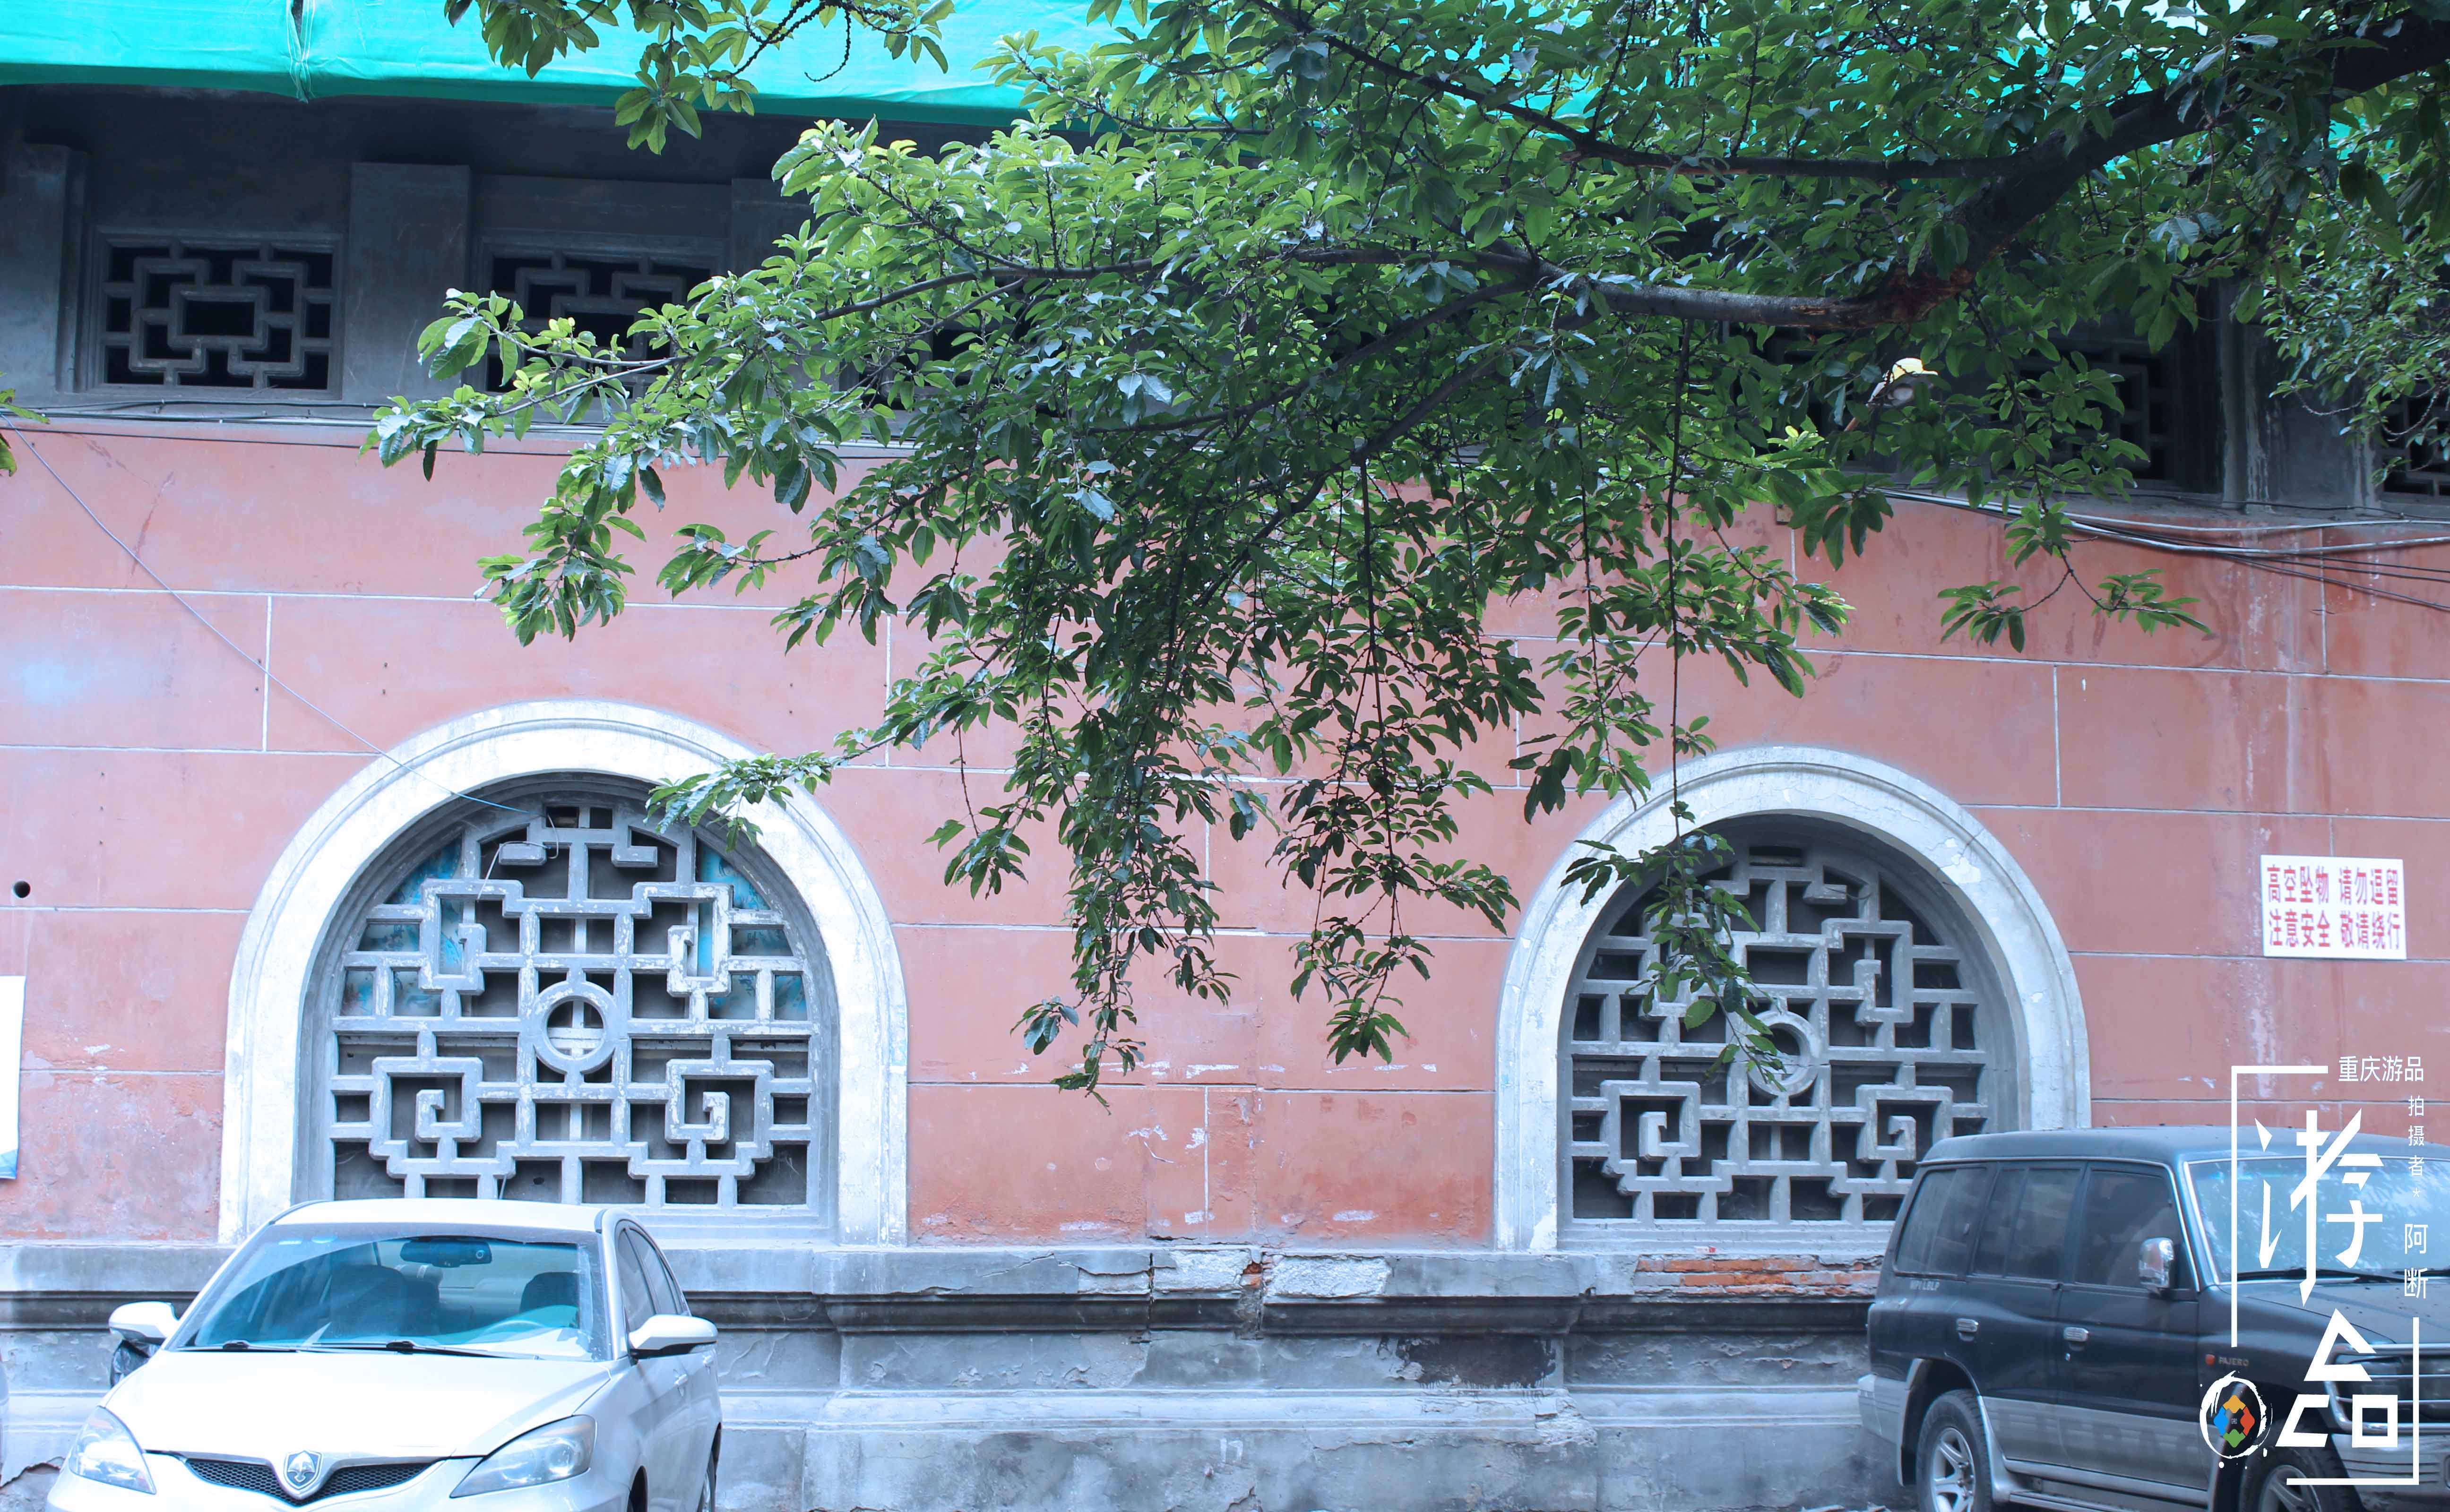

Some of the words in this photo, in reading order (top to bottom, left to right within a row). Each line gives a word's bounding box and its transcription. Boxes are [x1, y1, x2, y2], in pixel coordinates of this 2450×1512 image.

[2267, 864, 2329, 904] 高空坠物
[2338, 866, 2398, 906] 请勿逗留
[2268, 909, 2330, 947] 注意安全
[2339, 910, 2400, 949] 敬请绕行
[2218, 1356, 2249, 1366] PAJERO
